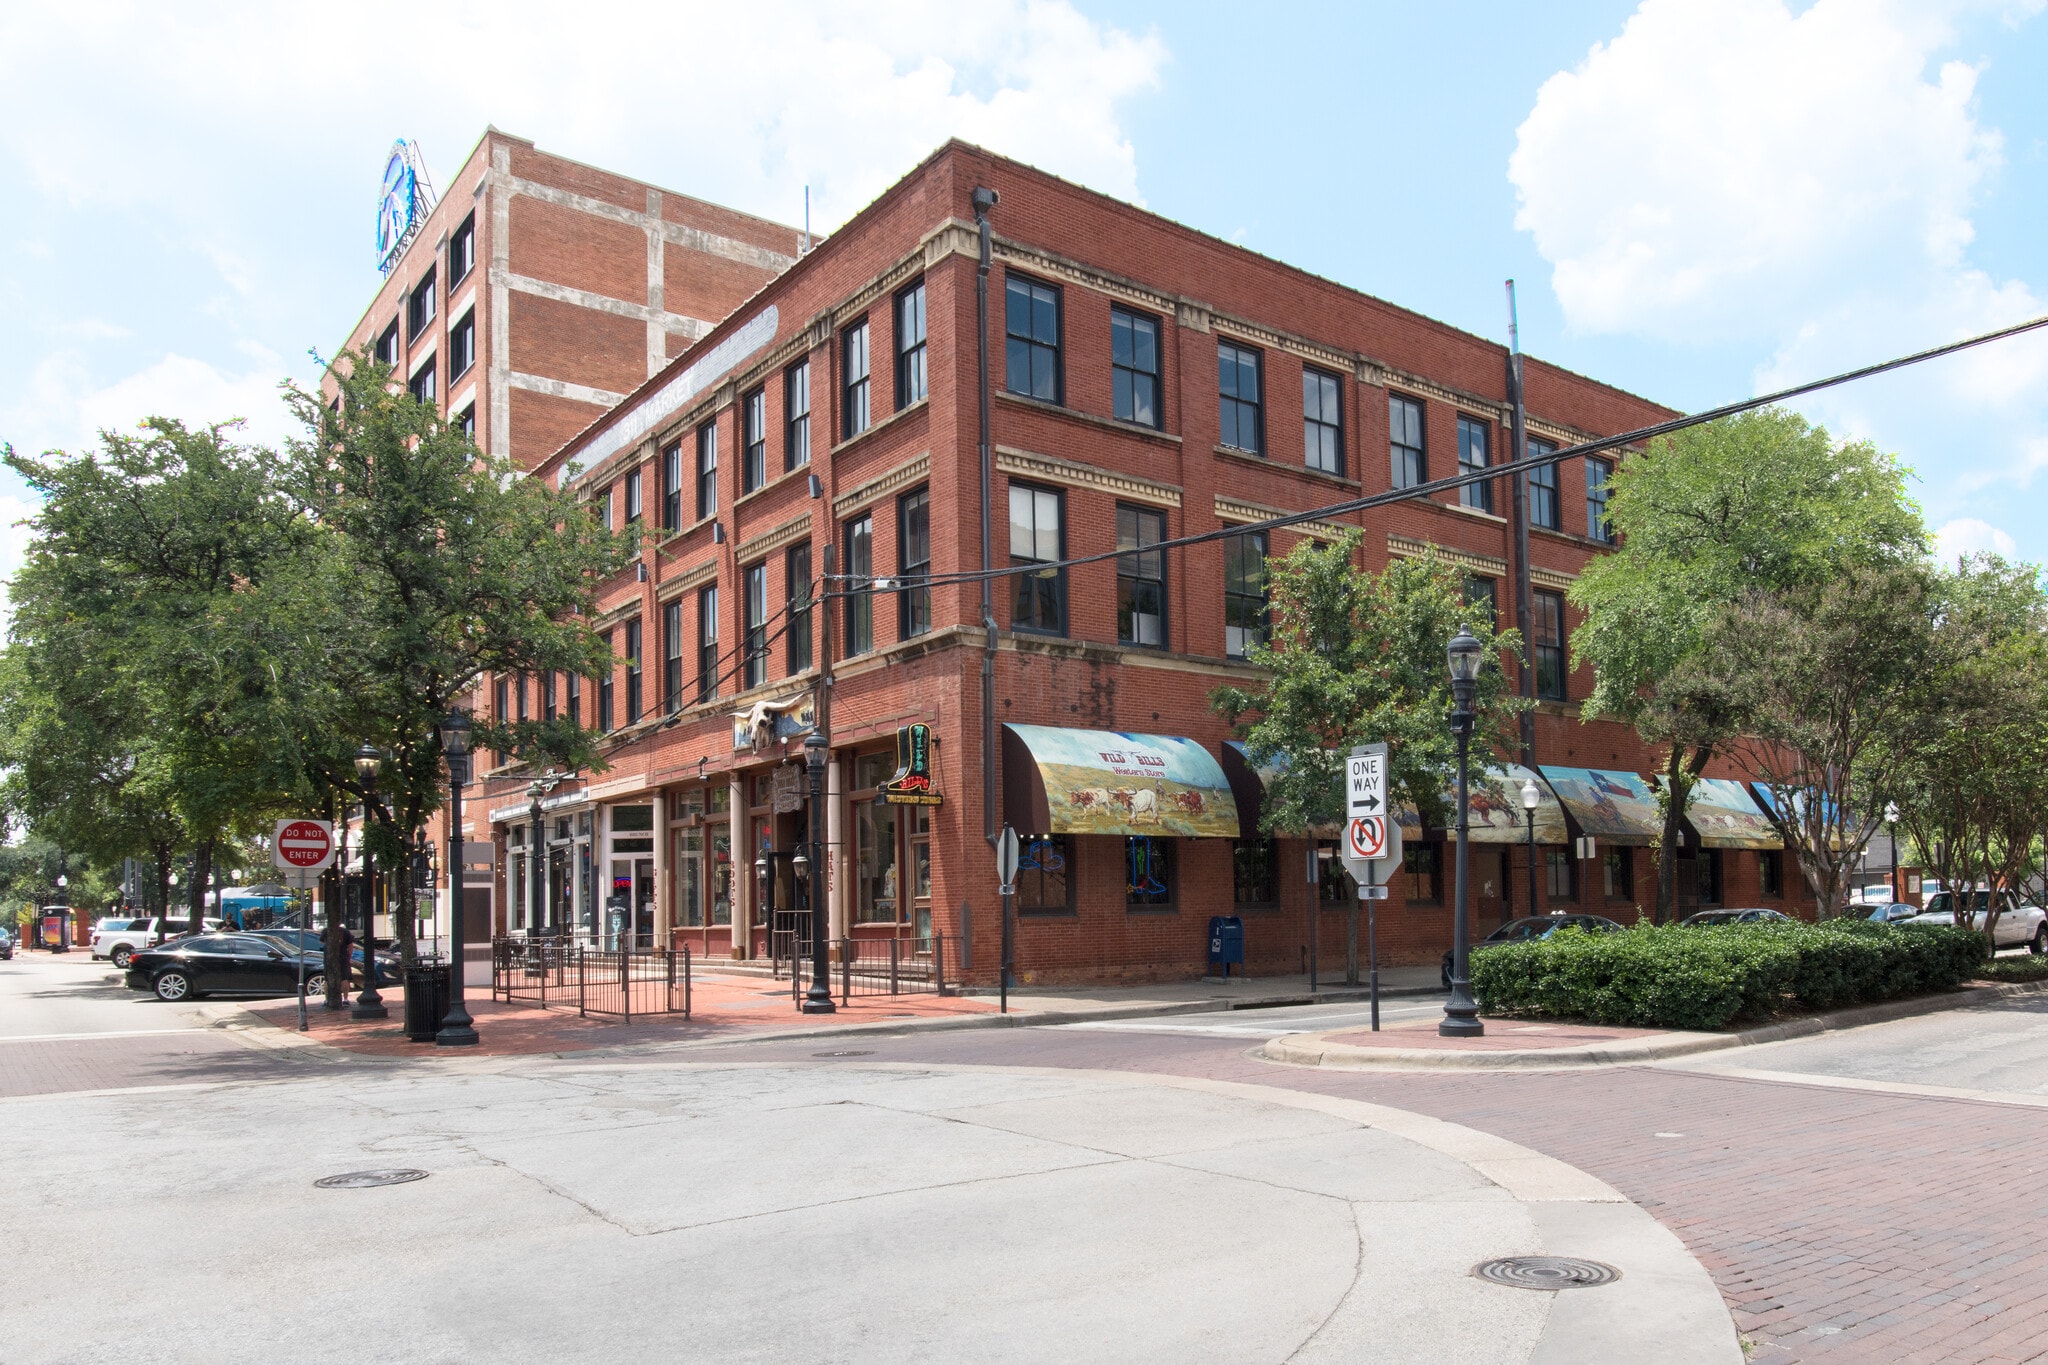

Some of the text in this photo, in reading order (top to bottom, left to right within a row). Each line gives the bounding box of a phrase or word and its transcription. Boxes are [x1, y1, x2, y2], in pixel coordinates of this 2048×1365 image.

[622, 374, 694, 441] 311 MARKET
[914, 725, 925, 772] WILD
[1098, 752, 1125, 763] WILD
[1112, 766, 1166, 778] Western Store
[1352, 760, 1378, 775] ONE
[1353, 776, 1379, 792] WAY
[286, 829, 323, 838] DO NOT
[289, 851, 319, 860] ENTER
[612, 880, 632, 889] OPEN
